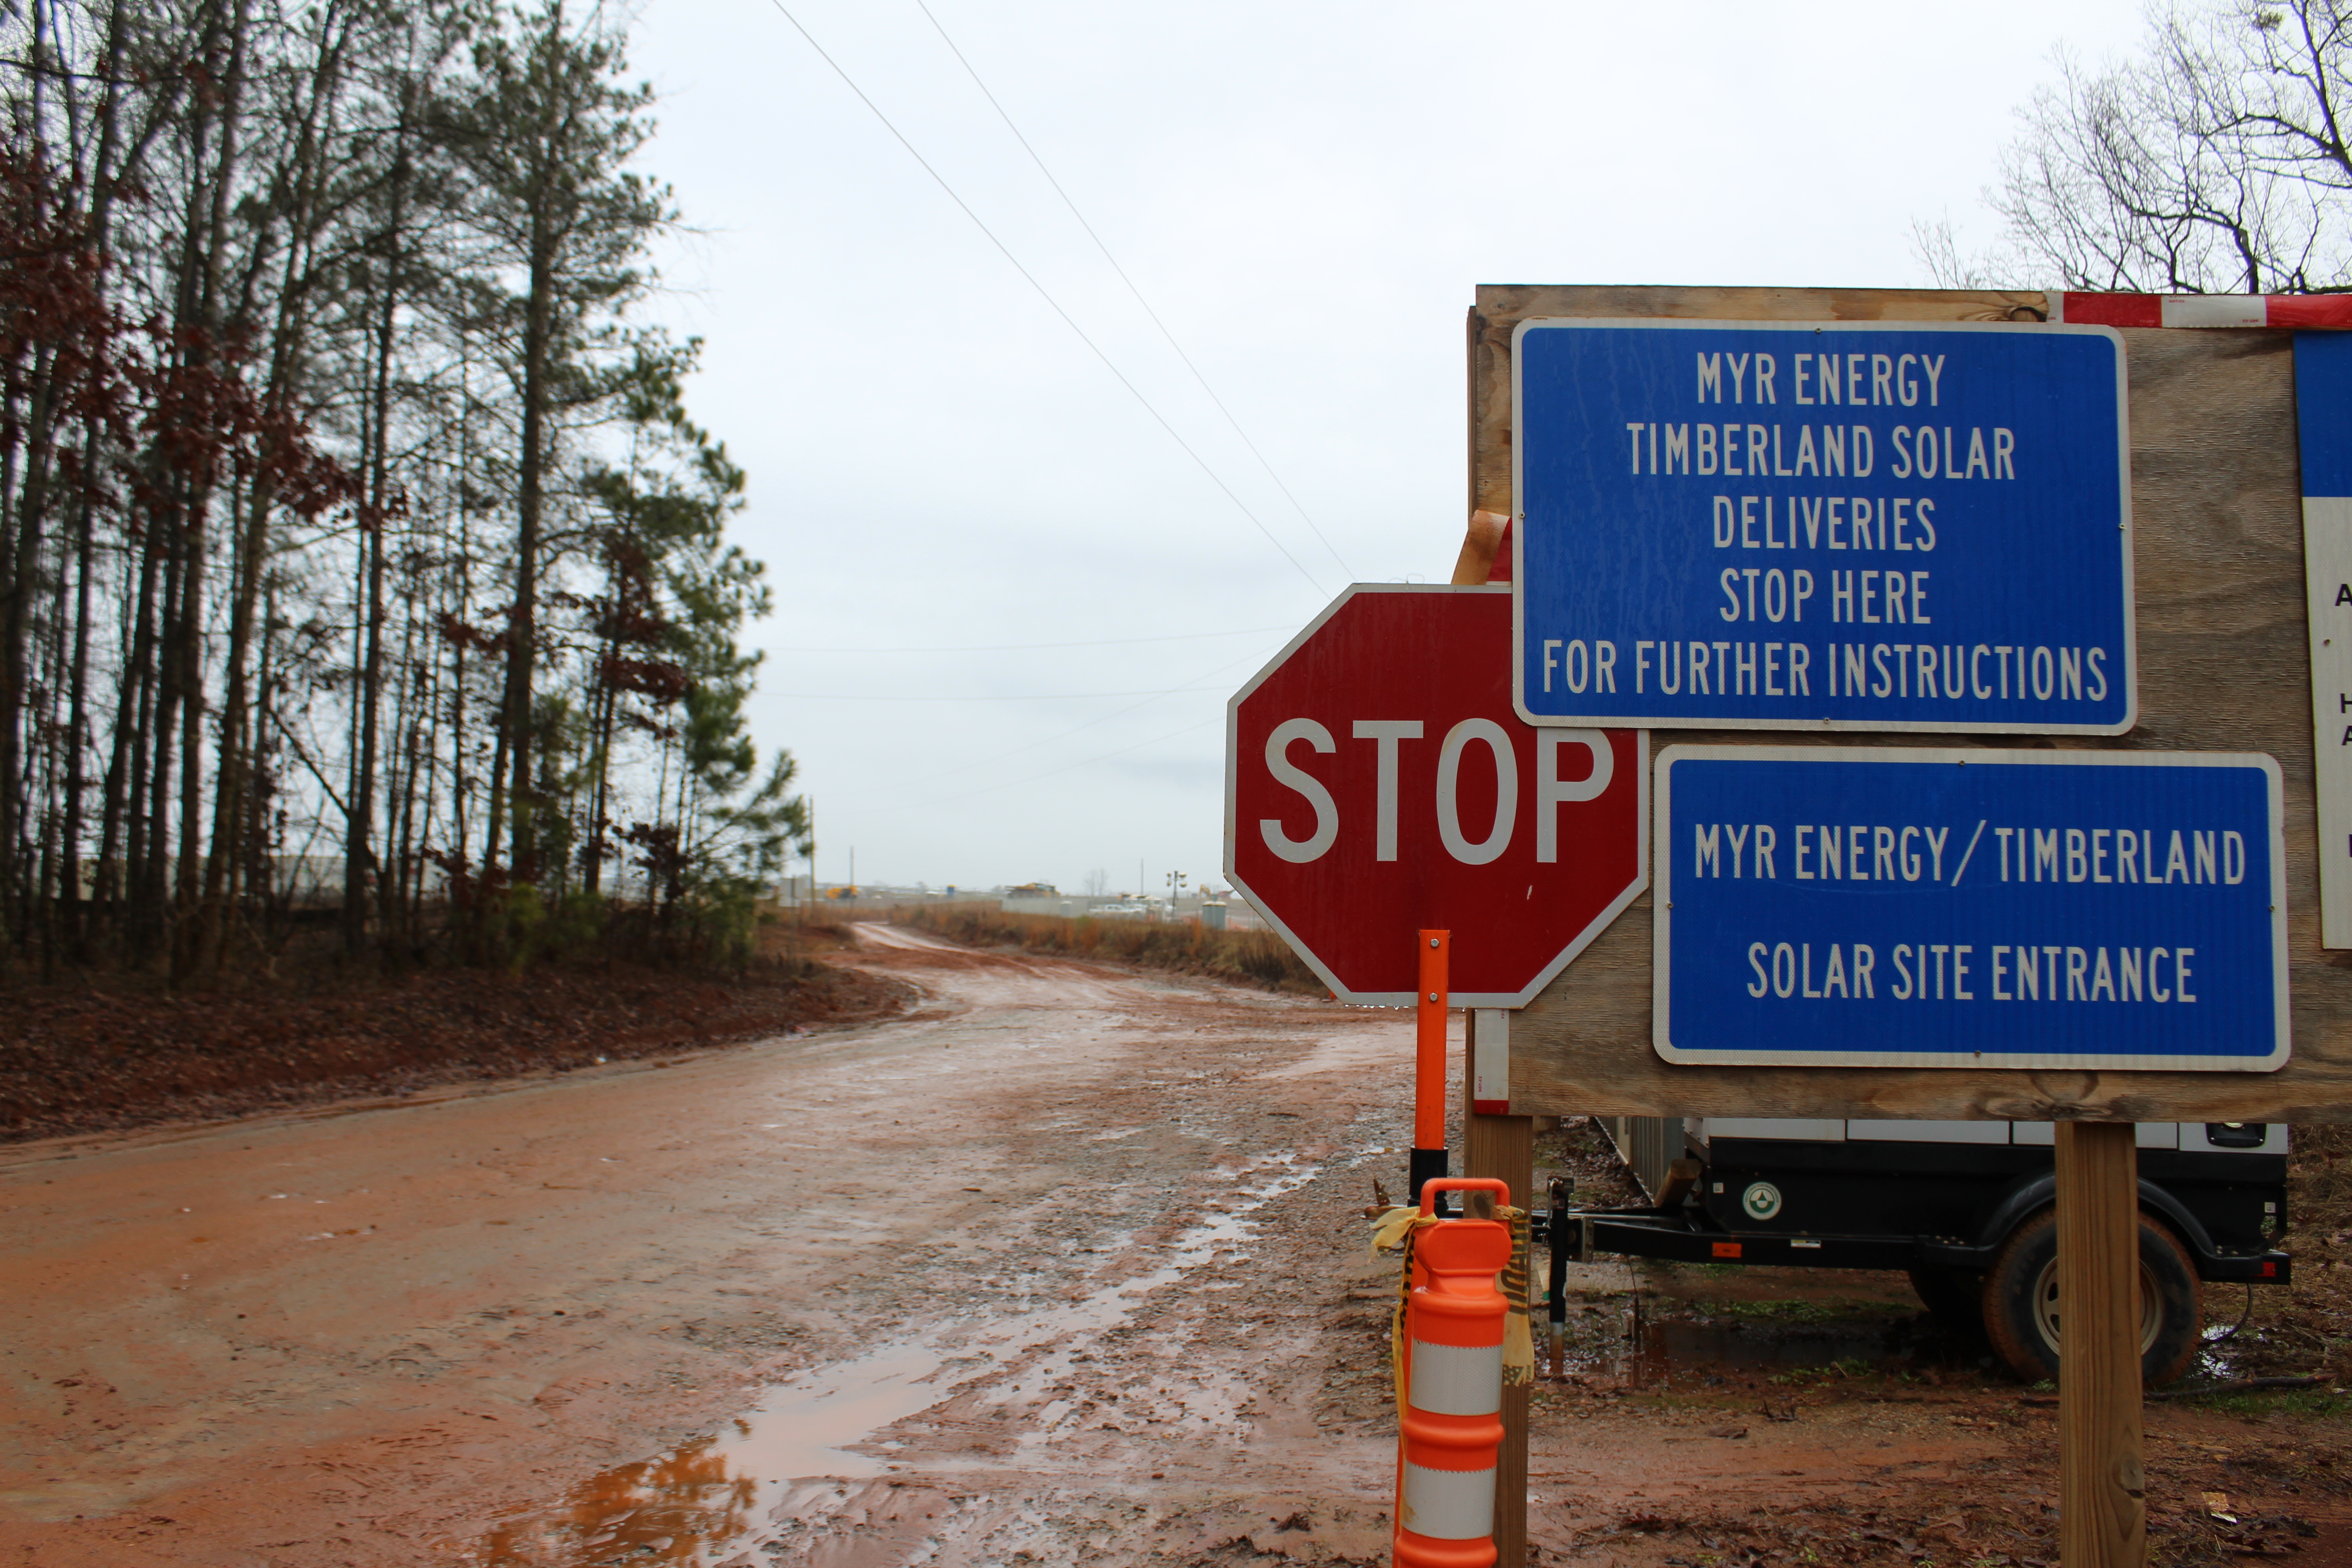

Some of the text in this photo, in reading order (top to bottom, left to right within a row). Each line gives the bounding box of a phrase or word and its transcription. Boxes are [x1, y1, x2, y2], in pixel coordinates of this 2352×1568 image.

[1698, 352, 1945, 407] MYR ENERGY
[1627, 422, 2015, 480] TIMBERLAND SOLAR
[1714, 495, 1936, 551] DELIVERIES
[1720, 568, 1931, 624] STOP HERE
[1544, 639, 2107, 701] FOR FURTHER INSTRUCTIONS
[1259, 718, 1614, 865] STOP
[1696, 824, 1776, 879] MYR
[1747, 942, 2196, 1003] SOLAR SITE ENTRANCE
